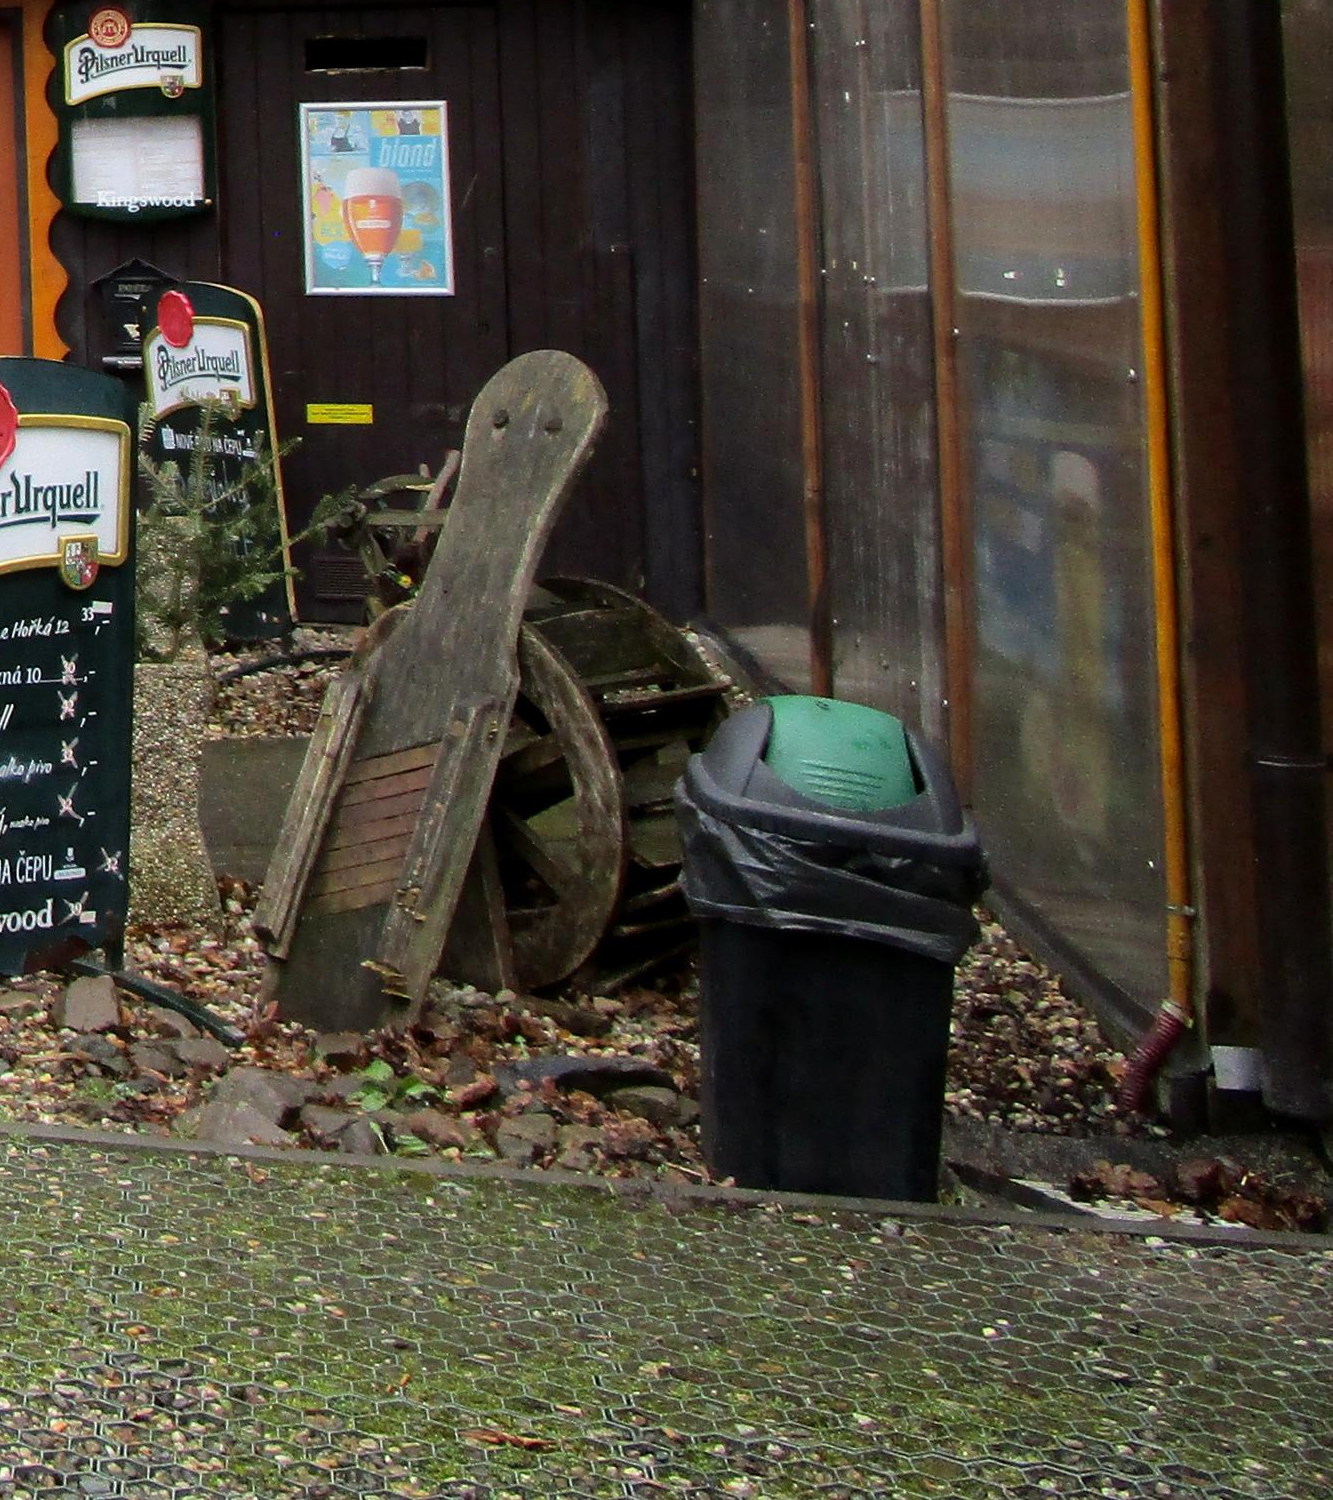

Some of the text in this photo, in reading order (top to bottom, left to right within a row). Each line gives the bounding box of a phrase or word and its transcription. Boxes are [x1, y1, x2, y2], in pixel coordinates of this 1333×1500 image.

[78, 44, 186, 84] Pilsner Urquell
[96, 191, 195, 212] Kingswood
[157, 344, 240, 391] Pilsner Urquell
[10, 470, 99, 528] Urquell
[12, 615, 54, 638] Hořká
[54, 619, 70, 634] 12
[26, 667, 42, 684] 10
[26, 759, 53, 784] pivo
[15, 850, 53, 883] ČEPU
